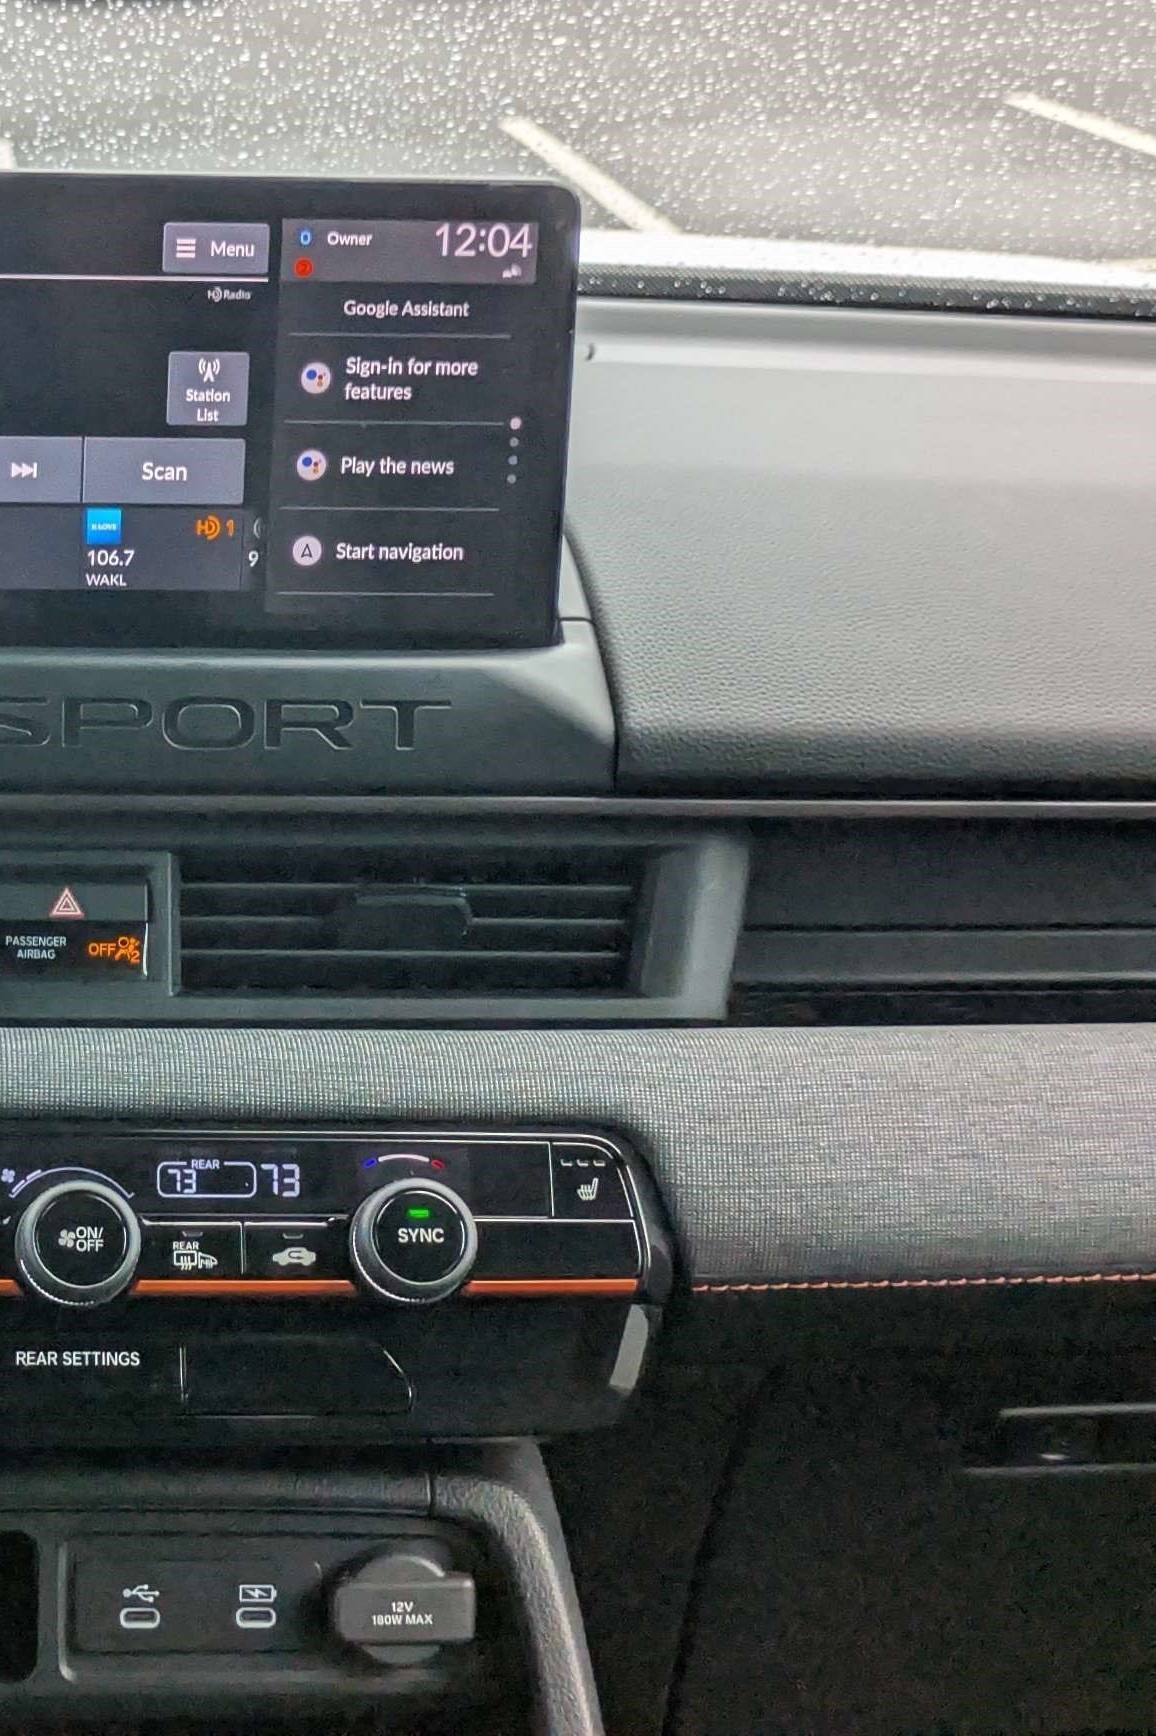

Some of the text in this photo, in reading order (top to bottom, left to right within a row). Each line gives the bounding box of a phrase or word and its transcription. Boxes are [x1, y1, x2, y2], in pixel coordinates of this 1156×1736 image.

[327, 231, 373, 246] Owner
[435, 223, 533, 258] 12:04
[211, 240, 255, 257] Menu
[223, 289, 252, 301] Radio
[343, 301, 470, 318] Google Assistant
[345, 356, 479, 377] Sign-in for more
[185, 388, 231, 403] Station
[344, 382, 412, 402] features
[196, 408, 219, 422] List
[141, 462, 188, 482] Scan
[340, 456, 455, 476] Play the news
[226, 519, 236, 537] 1
[87, 550, 135, 567] 106.7
[248, 551, 260, 568] 9
[335, 542, 464, 563] Start navigation
[85, 573, 127, 587] WAKL
[5, 935, 67, 948] PASSENGER
[87, 942, 117, 957] OFF
[16, 948, 56, 960] AIRBAG
[191, 1159, 220, 1170] REAR
[167, 1168, 197, 1194] 73
[261, 1163, 301, 1198] 73
[75, 1226, 104, 1240] ON/
[397, 1227, 445, 1244] SYNC
[75, 1239, 104, 1253] OFF
[172, 1241, 200, 1251] REAR
[15, 1351, 141, 1367] REAR SETTINGS
[391, 1601, 414, 1613] 12V
[405, 1613, 434, 1625] MAX
